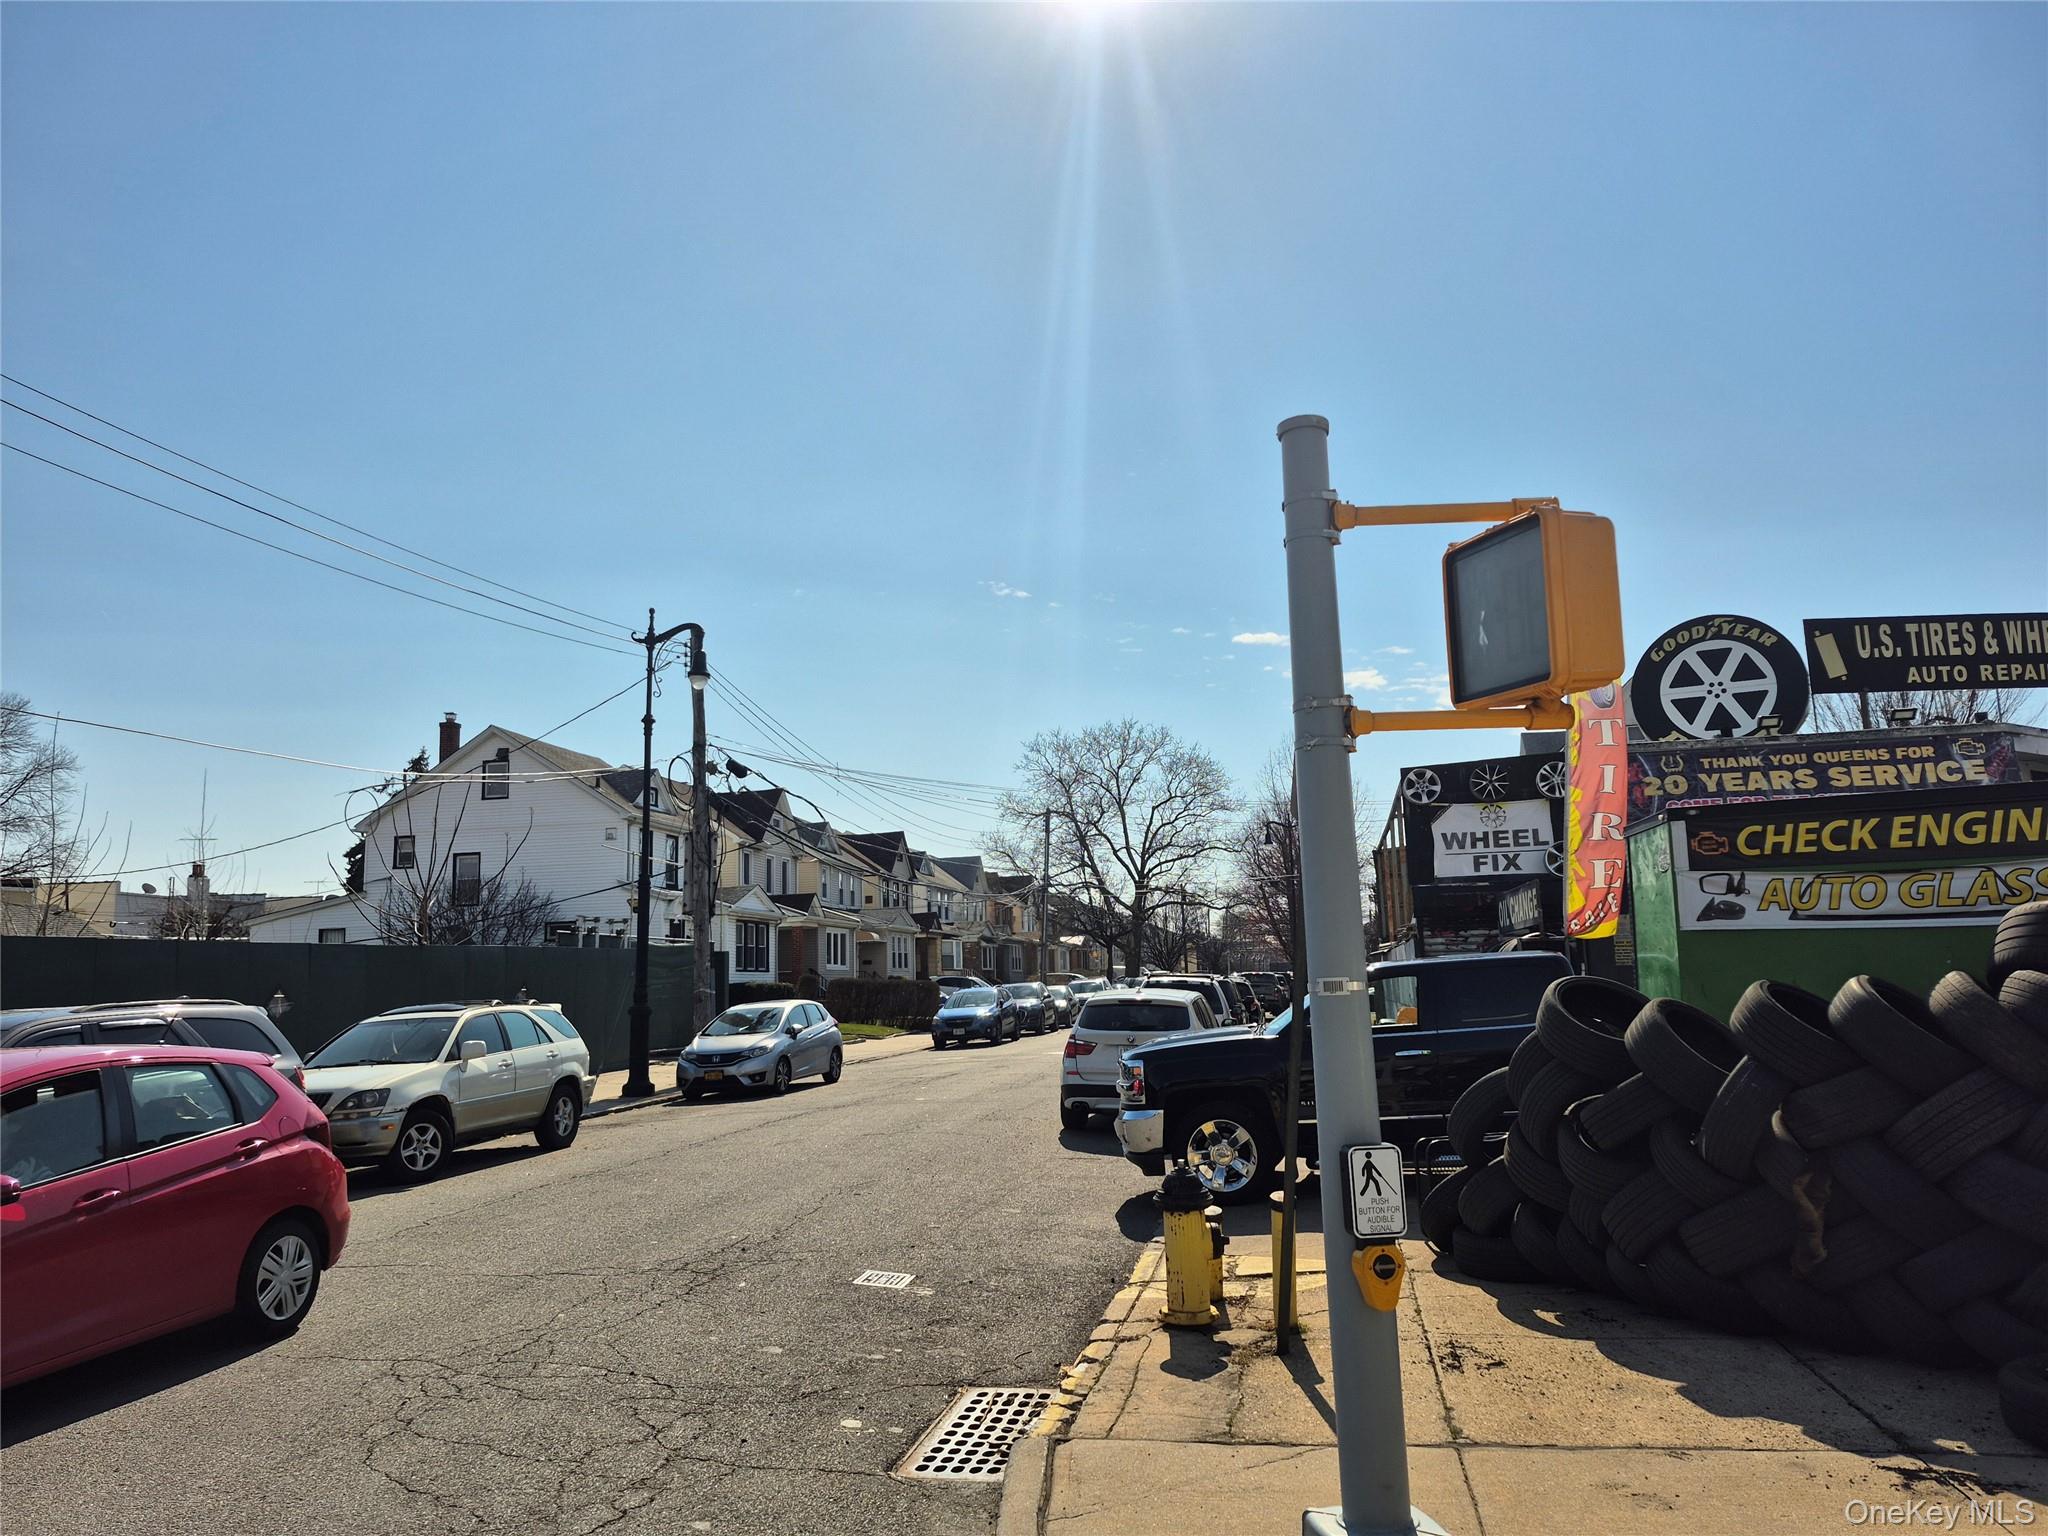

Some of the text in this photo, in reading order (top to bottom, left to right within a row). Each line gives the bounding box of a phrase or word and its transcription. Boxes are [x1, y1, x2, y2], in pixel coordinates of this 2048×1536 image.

[1649, 618, 1779, 663] GOODYEAR
[1854, 623, 1902, 659] U.S.
[1905, 621, 1977, 657] TIRES
[1983, 620, 2000, 654] &
[1907, 663, 2048, 684] AUTO REPAI
[1700, 745, 1935, 769] THANK YOU QUEENS FOR
[1642, 758, 1988, 797] 20 YEARS SERVICE
[1587, 718, 1625, 889] TIRE
[1441, 828, 1549, 850] WHEEL
[1736, 806, 2048, 856] CHECK ENGIN
[1473, 853, 1523, 873] FIX
[1757, 874, 1888, 912] AUTO
[1498, 887, 1539, 928] OIL CHANGE
[1358, 1205, 1401, 1216] BUTTON FOR
[1370, 1197, 1390, 1205] PUSH
[1367, 1214, 1395, 1224] AUDIBLE
[1369, 1224, 1394, 1233] SIGNAL
